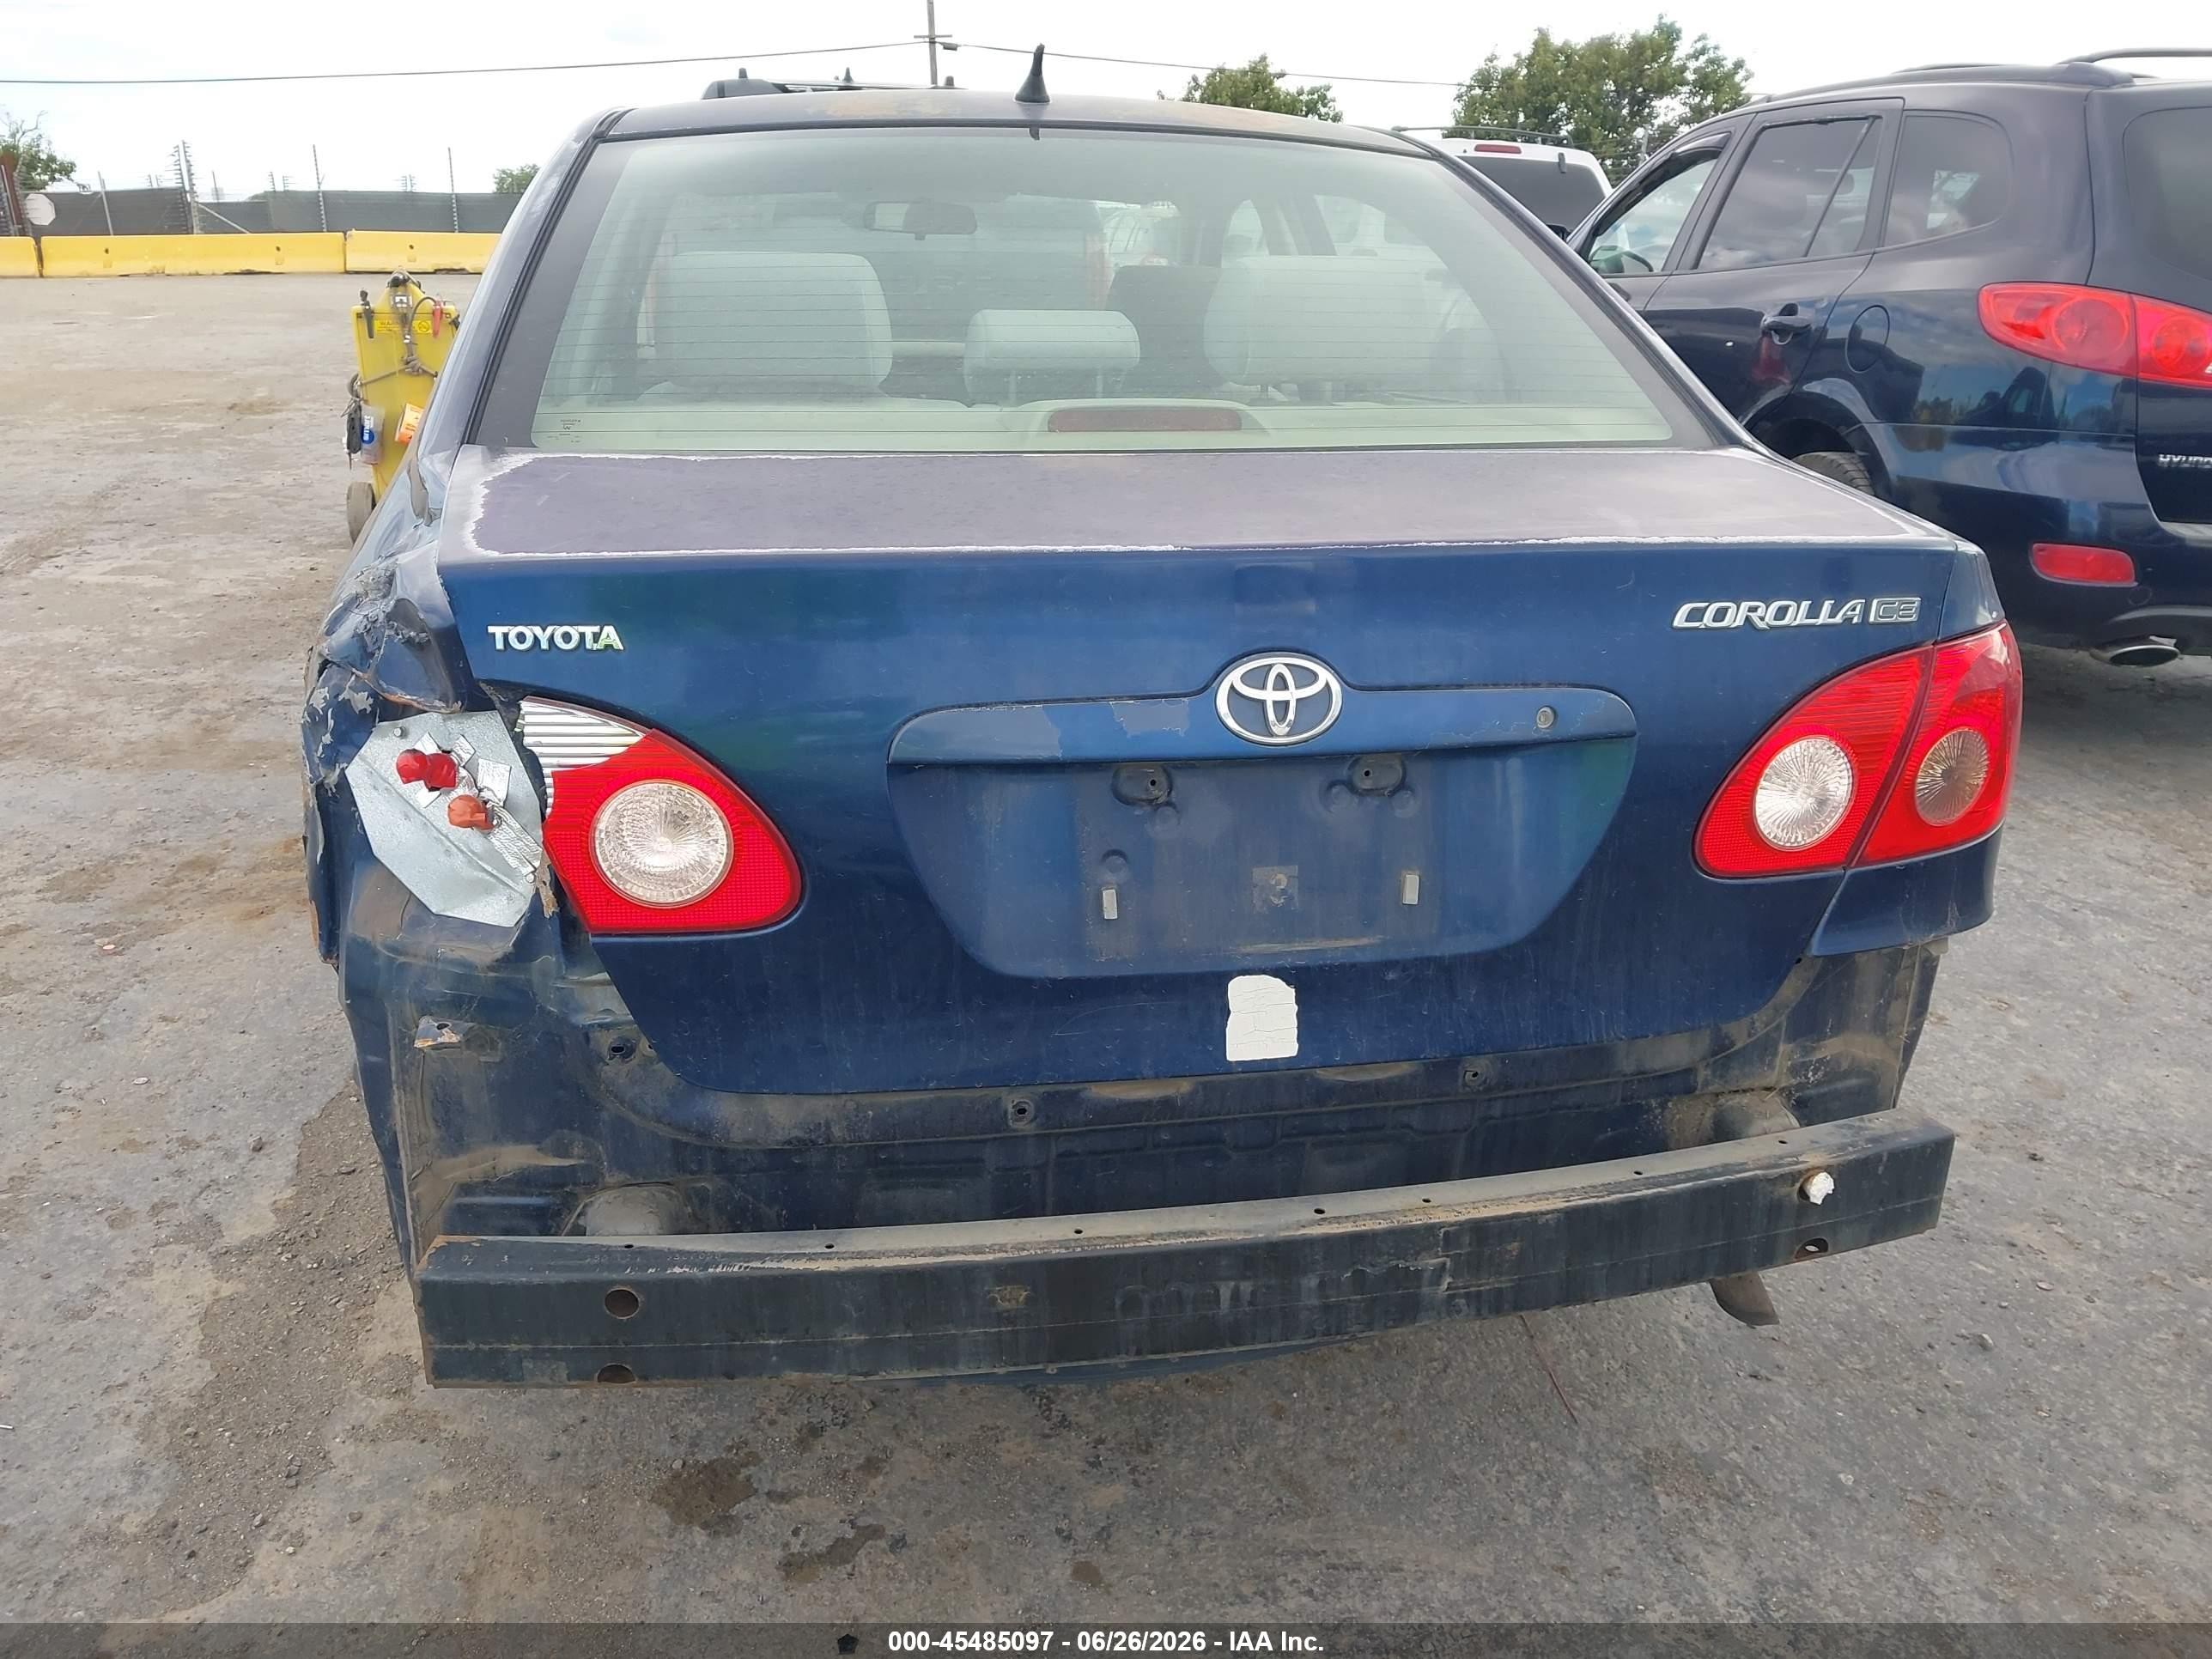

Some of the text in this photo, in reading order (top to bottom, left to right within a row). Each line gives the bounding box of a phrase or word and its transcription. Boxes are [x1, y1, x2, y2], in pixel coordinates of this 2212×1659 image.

[1672, 599, 1918, 630] COROLLA CE
[488, 625, 624, 651] TOYOTA
